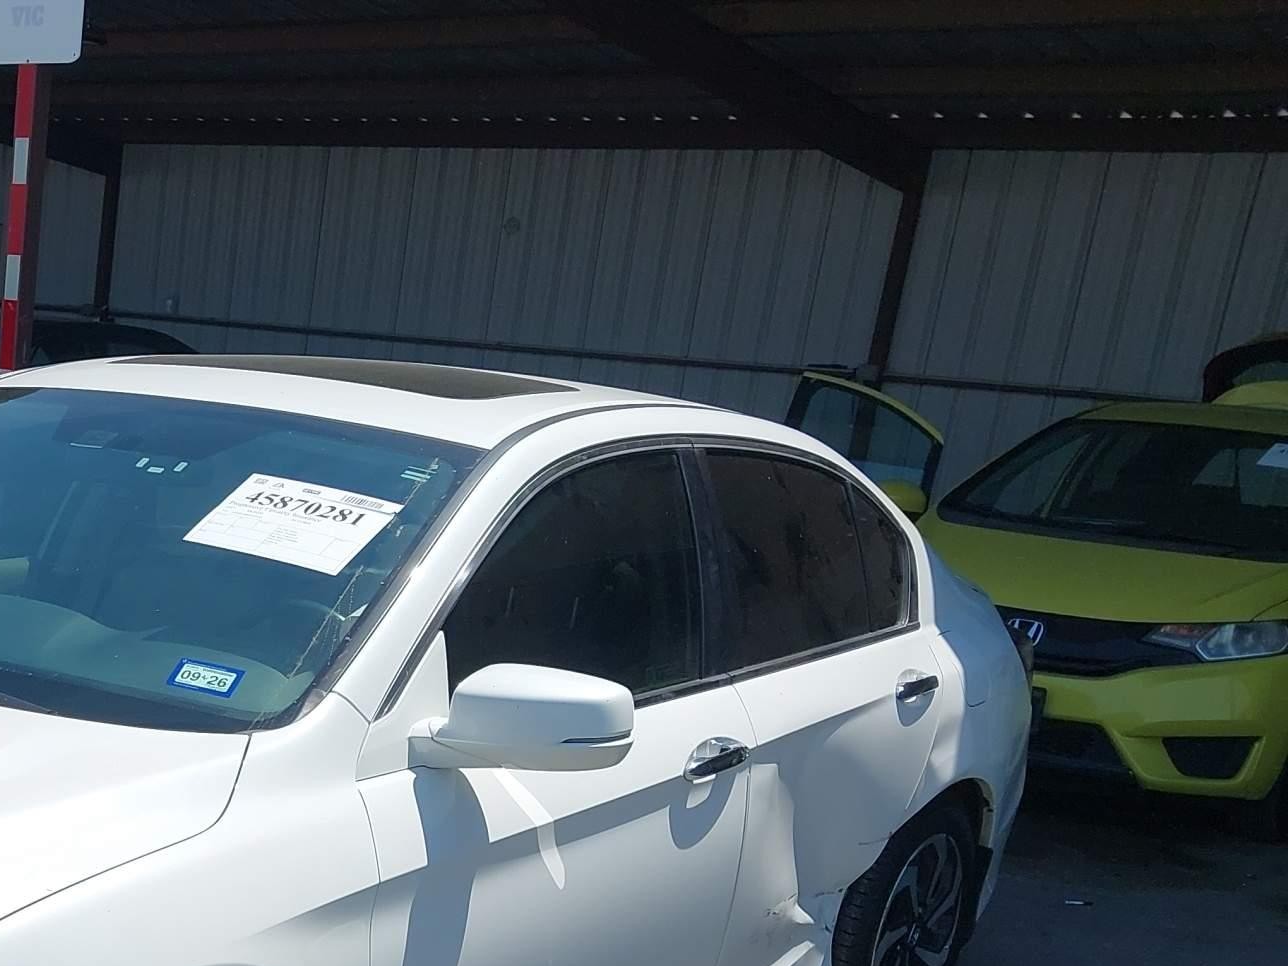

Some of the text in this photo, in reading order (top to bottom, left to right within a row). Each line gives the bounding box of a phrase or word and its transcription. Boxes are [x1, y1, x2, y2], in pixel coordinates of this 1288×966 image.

[245, 491, 367, 525] 45870281
[180, 669, 201, 682] 09
[206, 675, 229, 688] 26
